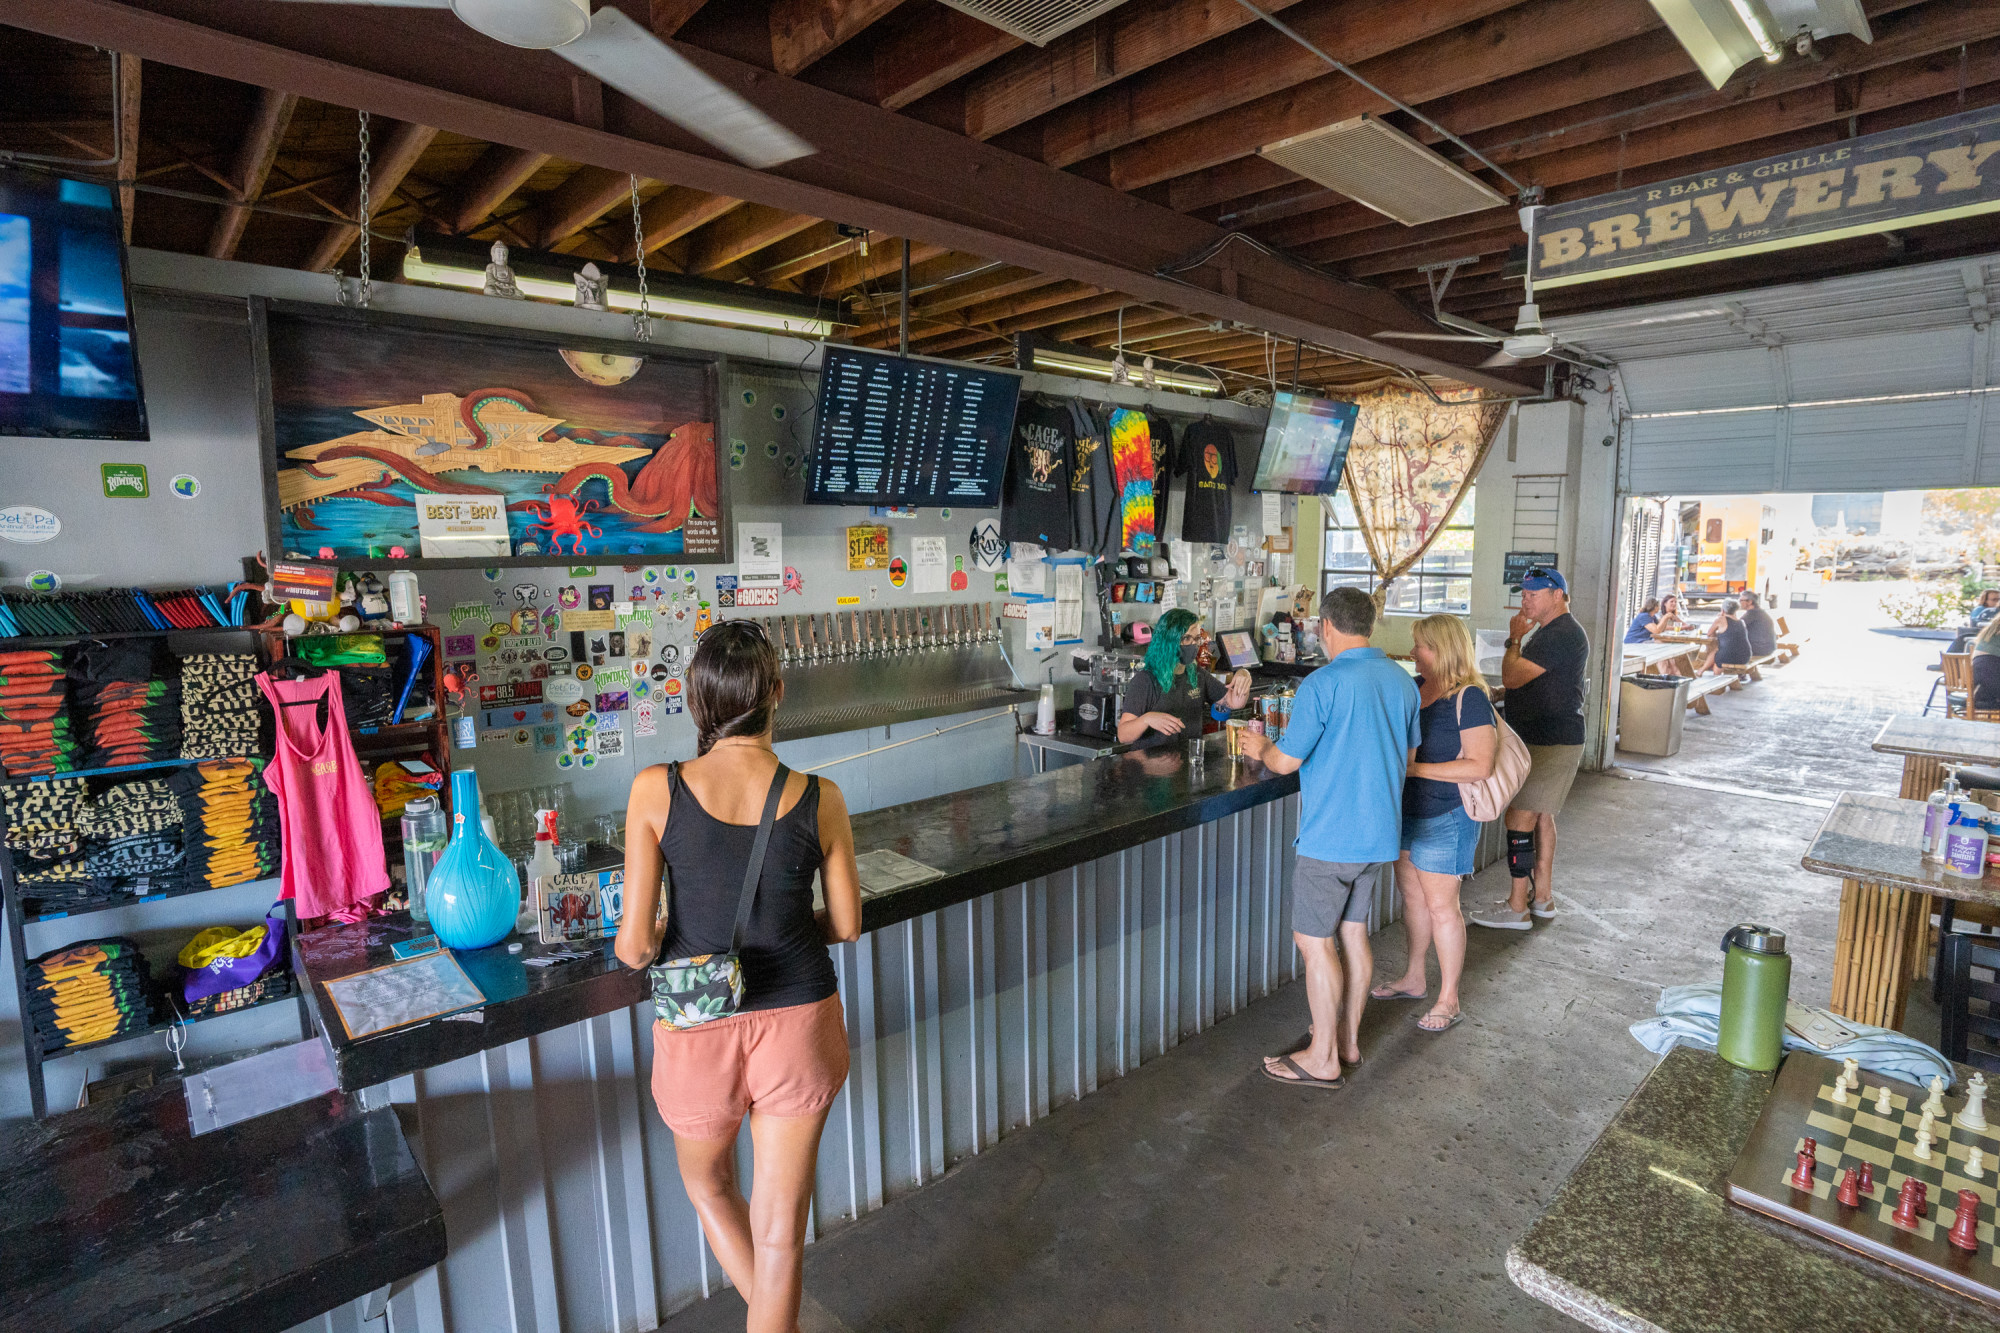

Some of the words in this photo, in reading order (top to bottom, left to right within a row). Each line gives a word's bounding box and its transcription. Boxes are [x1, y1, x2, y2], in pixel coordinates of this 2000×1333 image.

[1647, 189, 1662, 202] R
[1669, 177, 1719, 196] BAR
[1725, 171, 1745, 184] &
[1752, 147, 1852, 178] GRILLE
[1537, 140, 2000, 269] BREWERY
[1028, 423, 1059, 445] CAGE
[34, 514, 56, 525] Pal
[425, 504, 460, 520] BEST
[469, 504, 498, 520] BAY
[974, 534, 1005, 556] RAYS
[737, 588, 778, 605] #GOBUCS
[1003, 603, 1027, 618] #GOBUC
[593, 669, 632, 694] ROWDIES
[496, 684, 515, 699] 88.5
[487, 712, 492, 727] I
[314, 760, 338, 772] CAGE
[1951, 848, 1977, 856] HAND
[1951, 852, 1976, 861] SANITIZER
[553, 873, 588, 886] CAGE
[558, 885, 585, 893] BREWING
